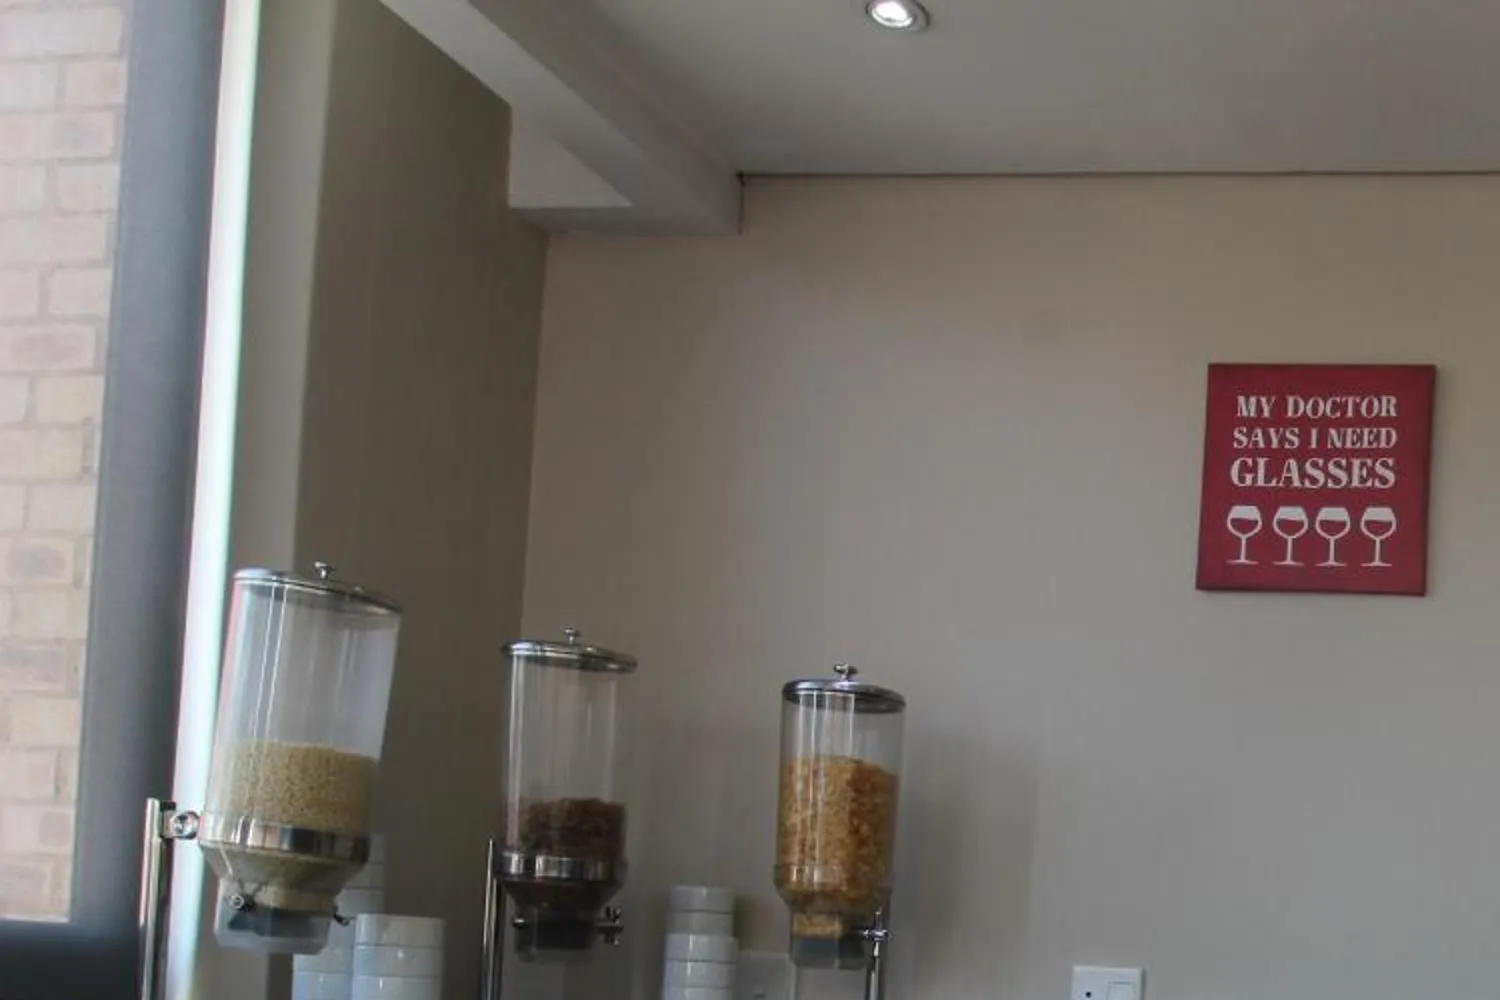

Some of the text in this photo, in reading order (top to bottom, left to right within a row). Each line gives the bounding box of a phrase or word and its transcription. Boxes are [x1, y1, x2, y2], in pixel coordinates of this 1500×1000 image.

[1236, 395, 1398, 419] MY DOCTOR
[1233, 427, 1398, 450] SAYS I NEED
[1230, 456, 1397, 489] GLASSES
